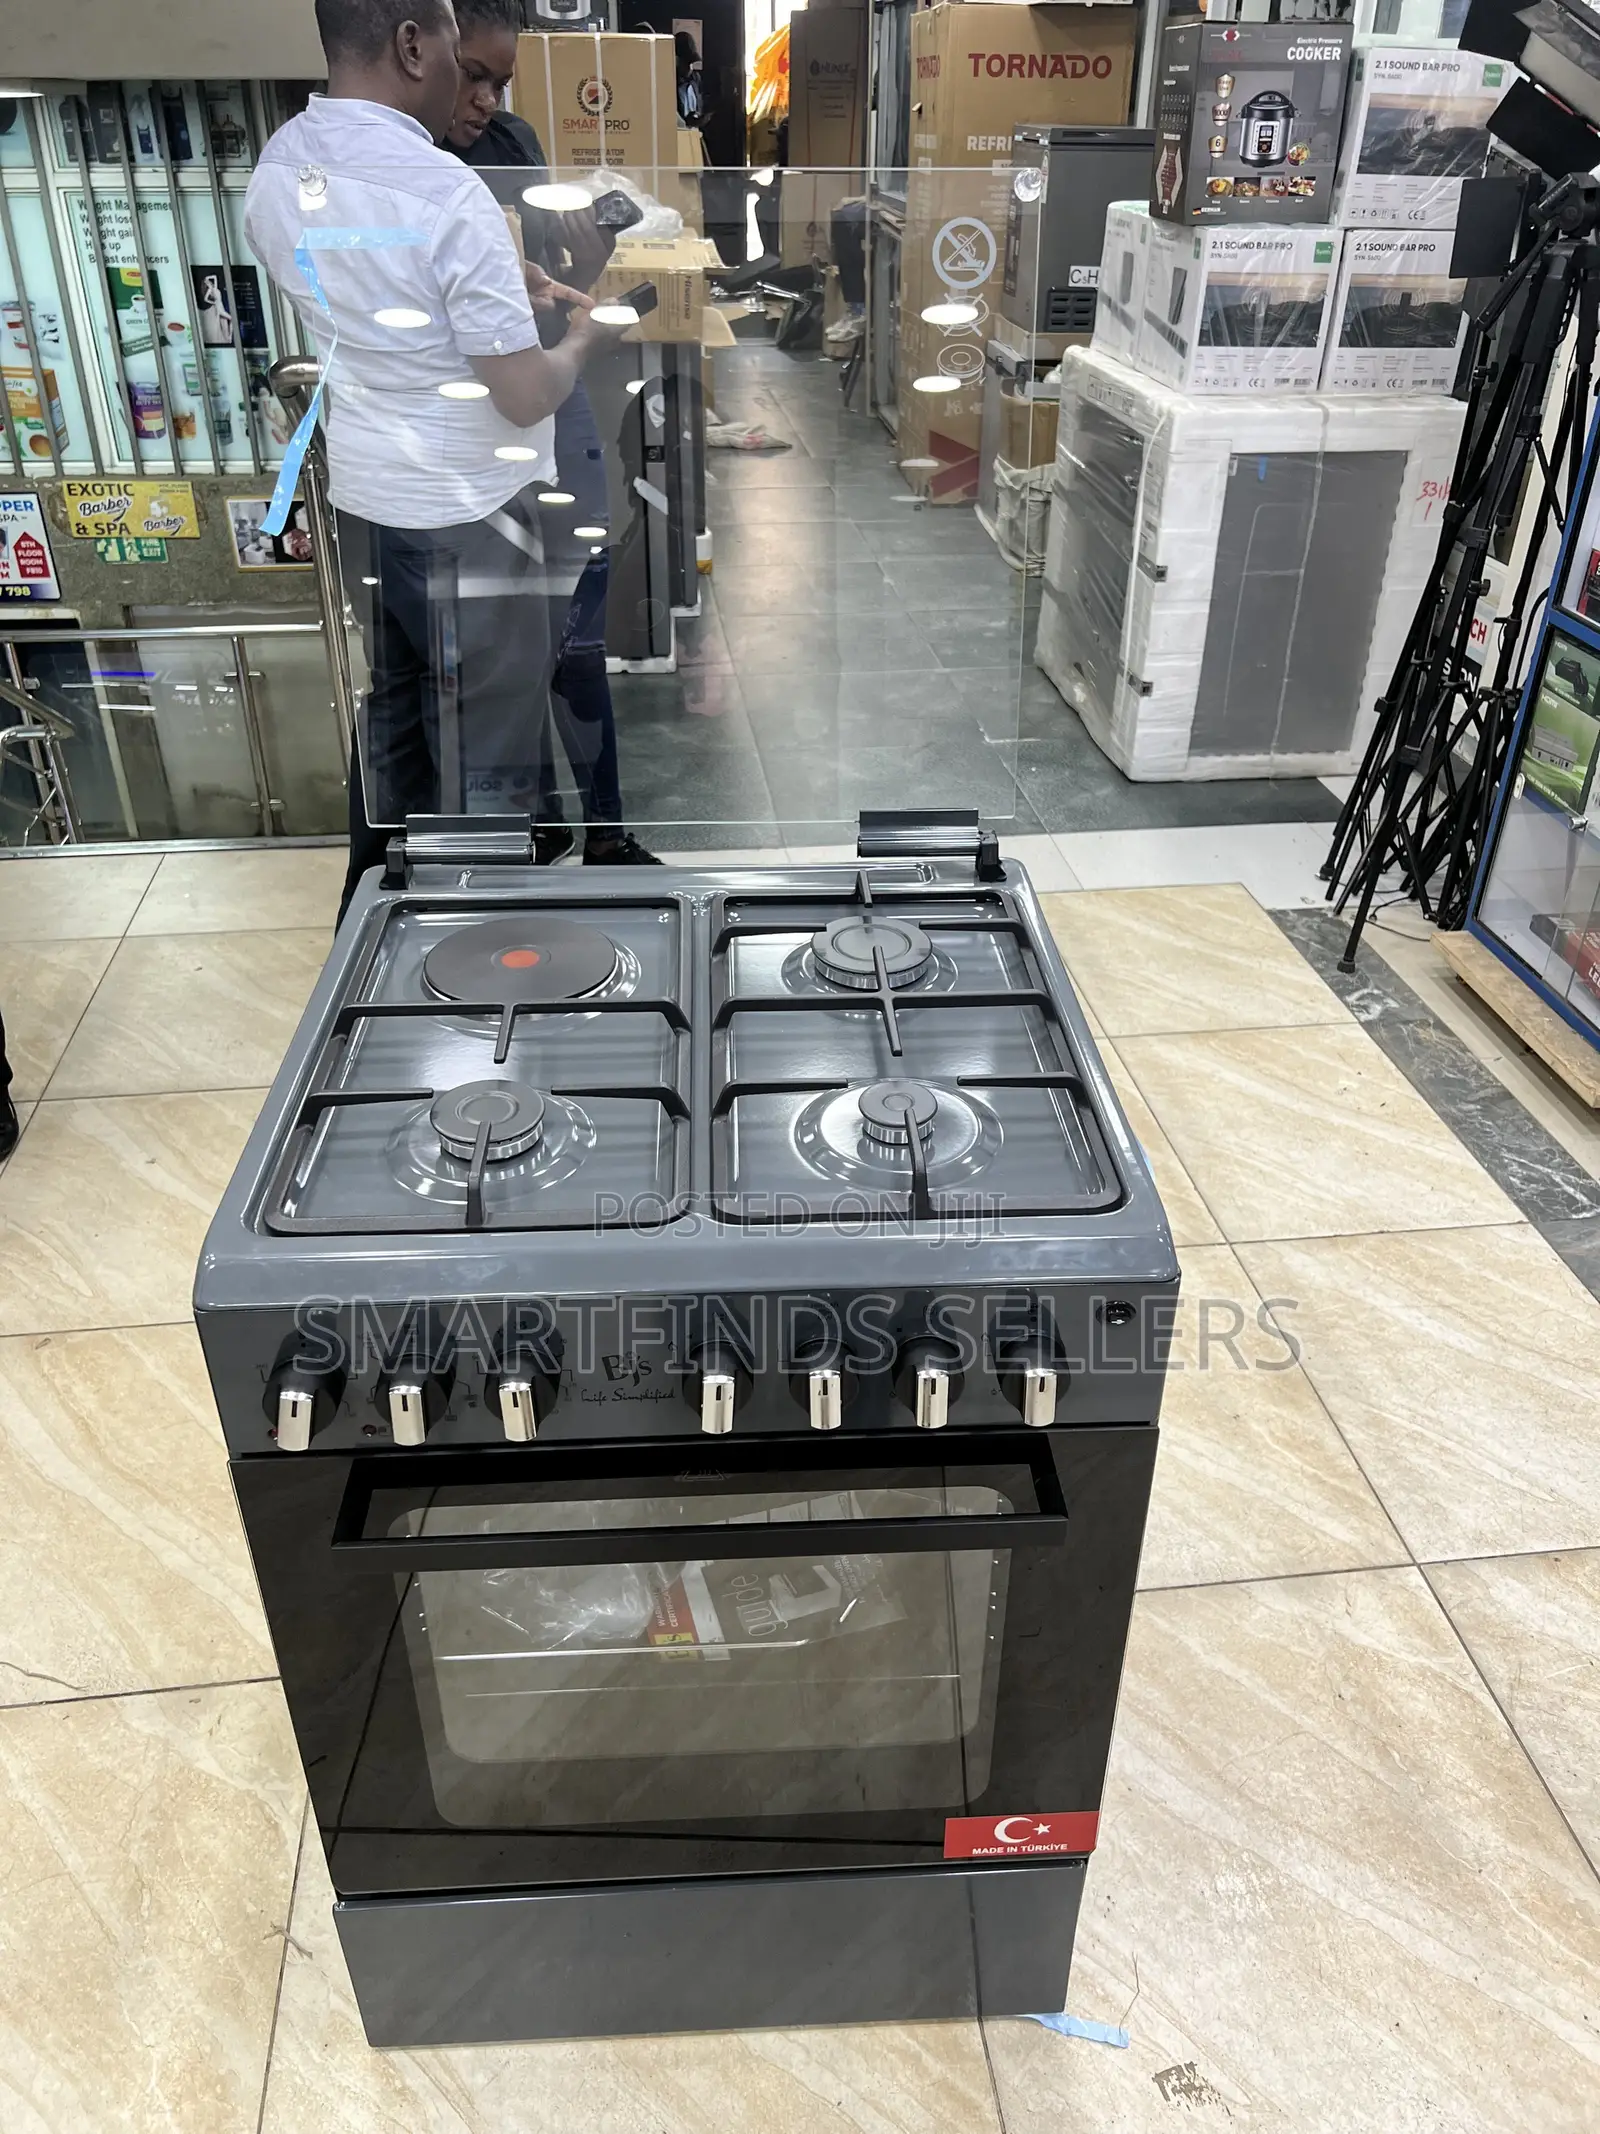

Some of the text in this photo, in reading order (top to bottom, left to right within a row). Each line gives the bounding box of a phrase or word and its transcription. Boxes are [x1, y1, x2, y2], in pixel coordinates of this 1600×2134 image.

[1287, 47, 1341, 60] COOKER
[917, 55, 941, 79] TORNADO
[968, 53, 1112, 79] TORNADO
[1389, 61, 1420, 70] SOUND
[1422, 62, 1440, 71] BAR
[1441, 63, 1460, 72] PRO
[967, 136, 1012, 151] REFRI
[77, 199, 112, 213] Wght
[80, 214, 113, 226] Wght
[83, 227, 117, 240] Wght
[109, 242, 121, 251] up
[1256, 242, 1273, 250] BAR
[1369, 243, 1398, 251] SOUND
[1418, 244, 1436, 252] PRO
[121, 254, 169, 263] enhncers
[66, 483, 135, 497] EXOTIC
[0, 501, 34, 511] PER
[79, 497, 132, 518] Barber
[75, 522, 131, 536] & SPA
[144, 516, 186, 532] Barber
[18, 549, 43, 557] FLOOR
[143, 547, 161, 557] EXIT
[20, 558, 43, 566] ROOM
[6, 586, 31, 596] 798
[581, 1387, 676, 1406] Life Simplified
[722, 1573, 788, 1636] guide
[972, 1847, 1004, 1855] MADE
[1021, 1843, 1068, 1852] TÜRKİYE
